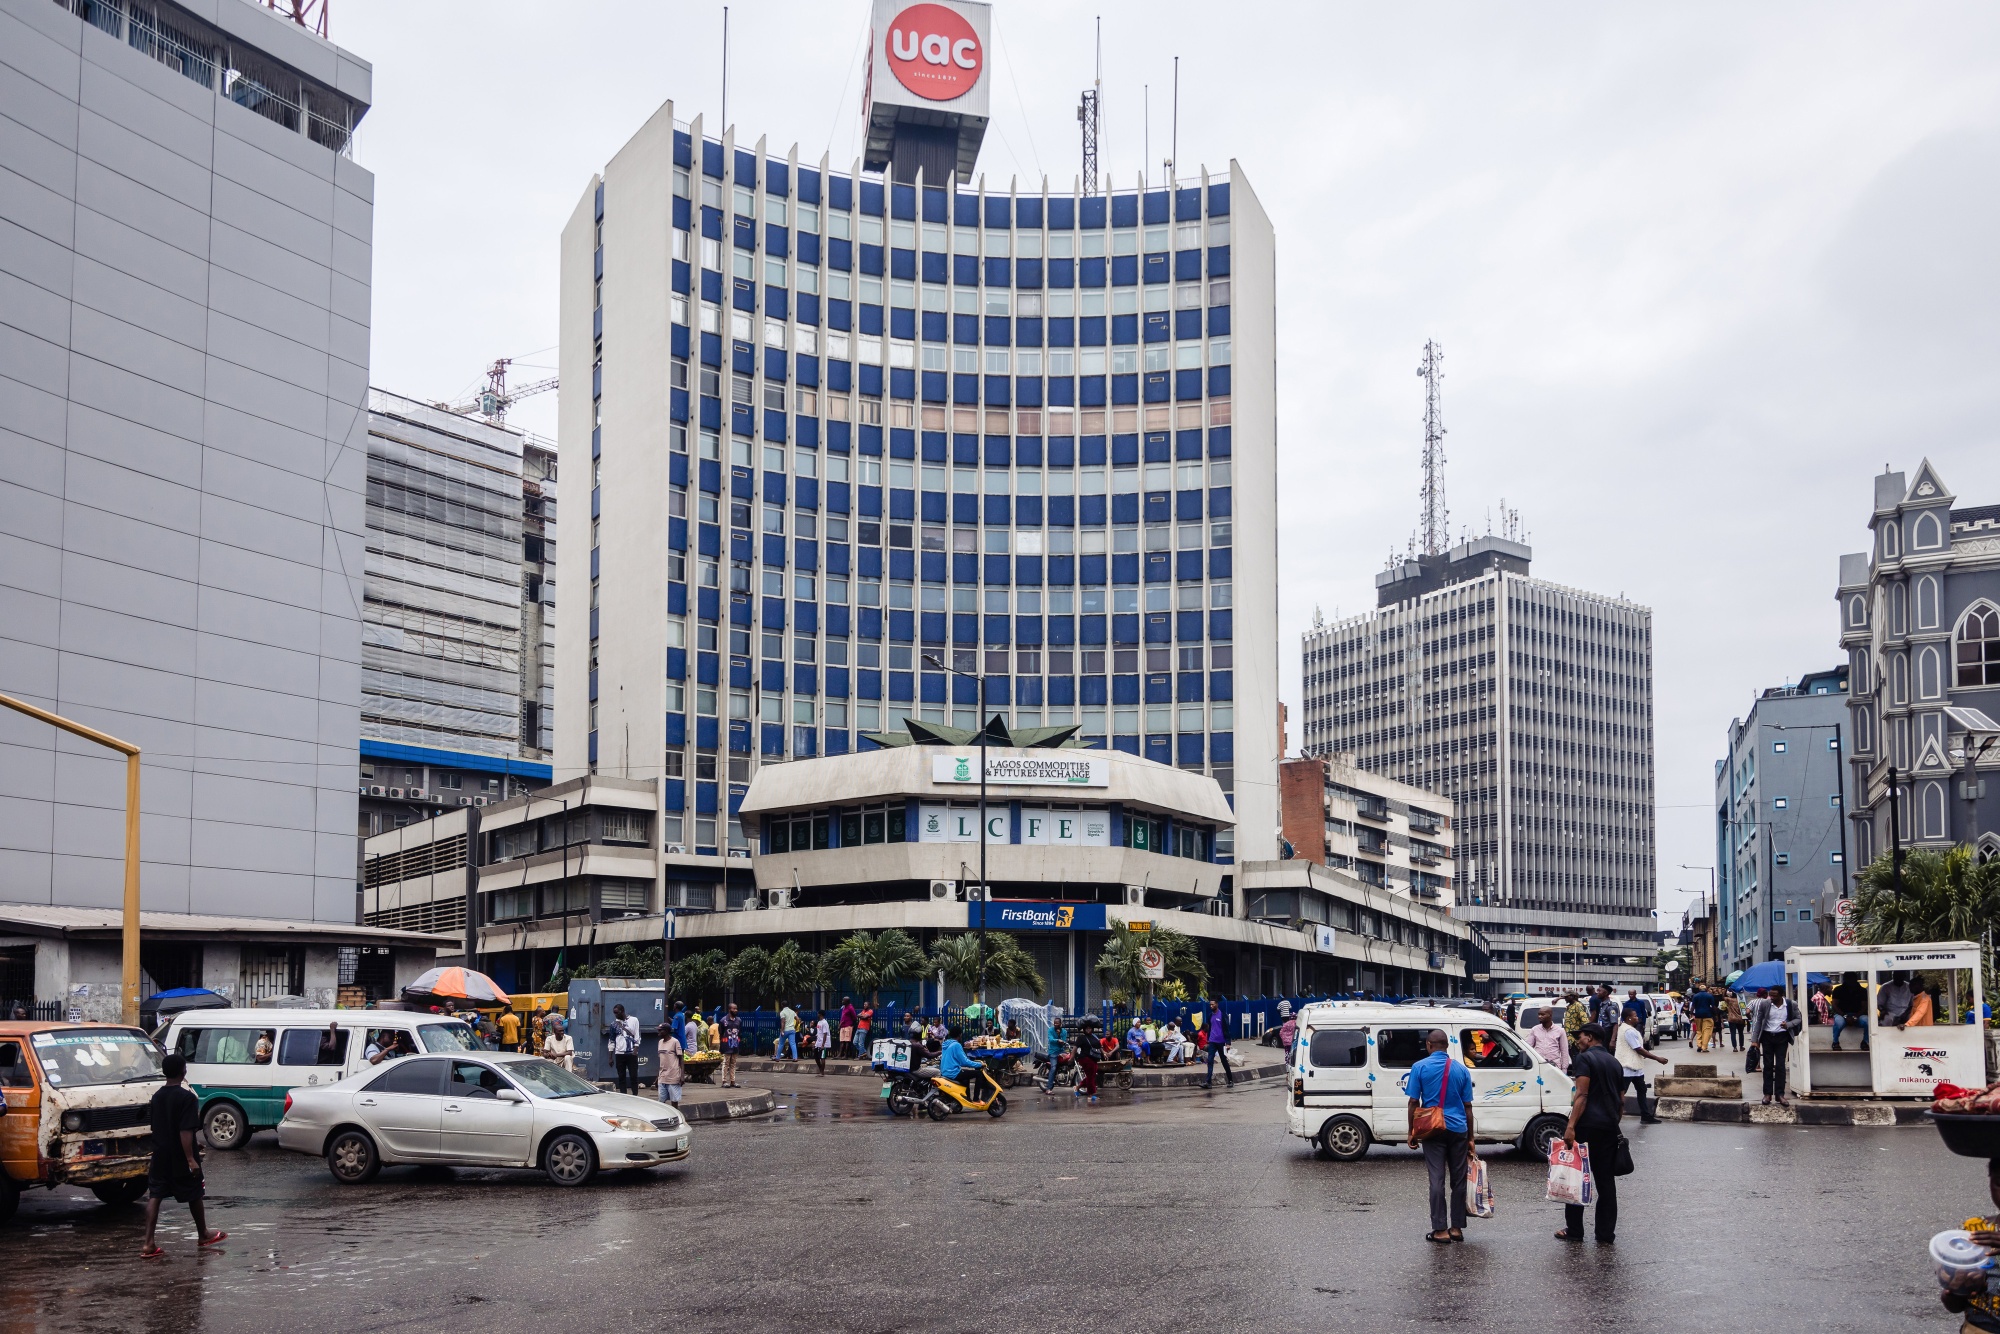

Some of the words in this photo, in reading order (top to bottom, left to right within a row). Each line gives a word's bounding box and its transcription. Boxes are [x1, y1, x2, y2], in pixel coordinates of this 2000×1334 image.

[892, 28, 977, 69] uac
[913, 71, 936, 79] since
[937, 74, 957, 82] 1879
[989, 760, 1021, 769] LAGOS
[1023, 761, 1090, 770] COMMODITIES
[985, 768, 992, 776] &
[994, 769, 1038, 777] FUTURES
[1039, 769, 1090, 779] EXCHANGE
[1001, 909, 1056, 921] FirstBank
[1904, 1050, 1947, 1058] MIKANO
[1899, 1076, 1951, 1084] mikano.com
